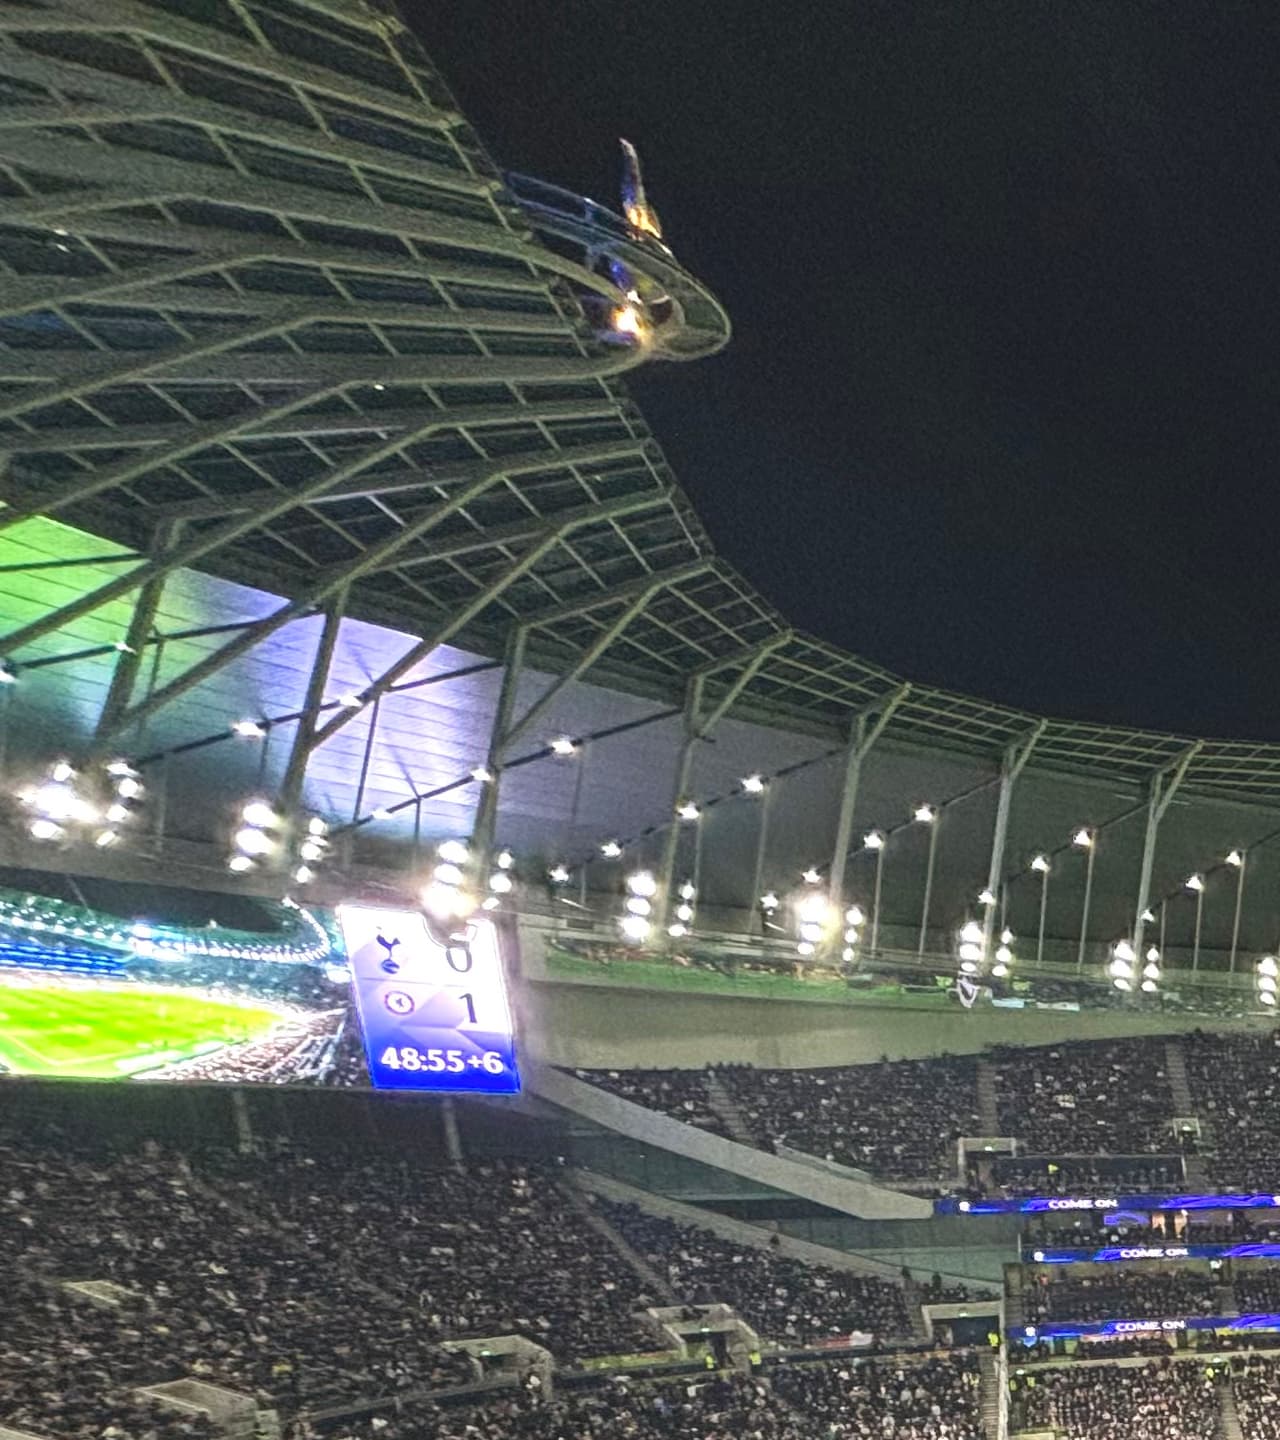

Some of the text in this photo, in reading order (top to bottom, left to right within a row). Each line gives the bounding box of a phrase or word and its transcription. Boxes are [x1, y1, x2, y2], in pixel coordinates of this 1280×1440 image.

[459, 993, 477, 1024] 1
[1095, 1198, 1118, 1208] ON
[1165, 1247, 1188, 1257] ON
[1162, 1320, 1186, 1330] ON
